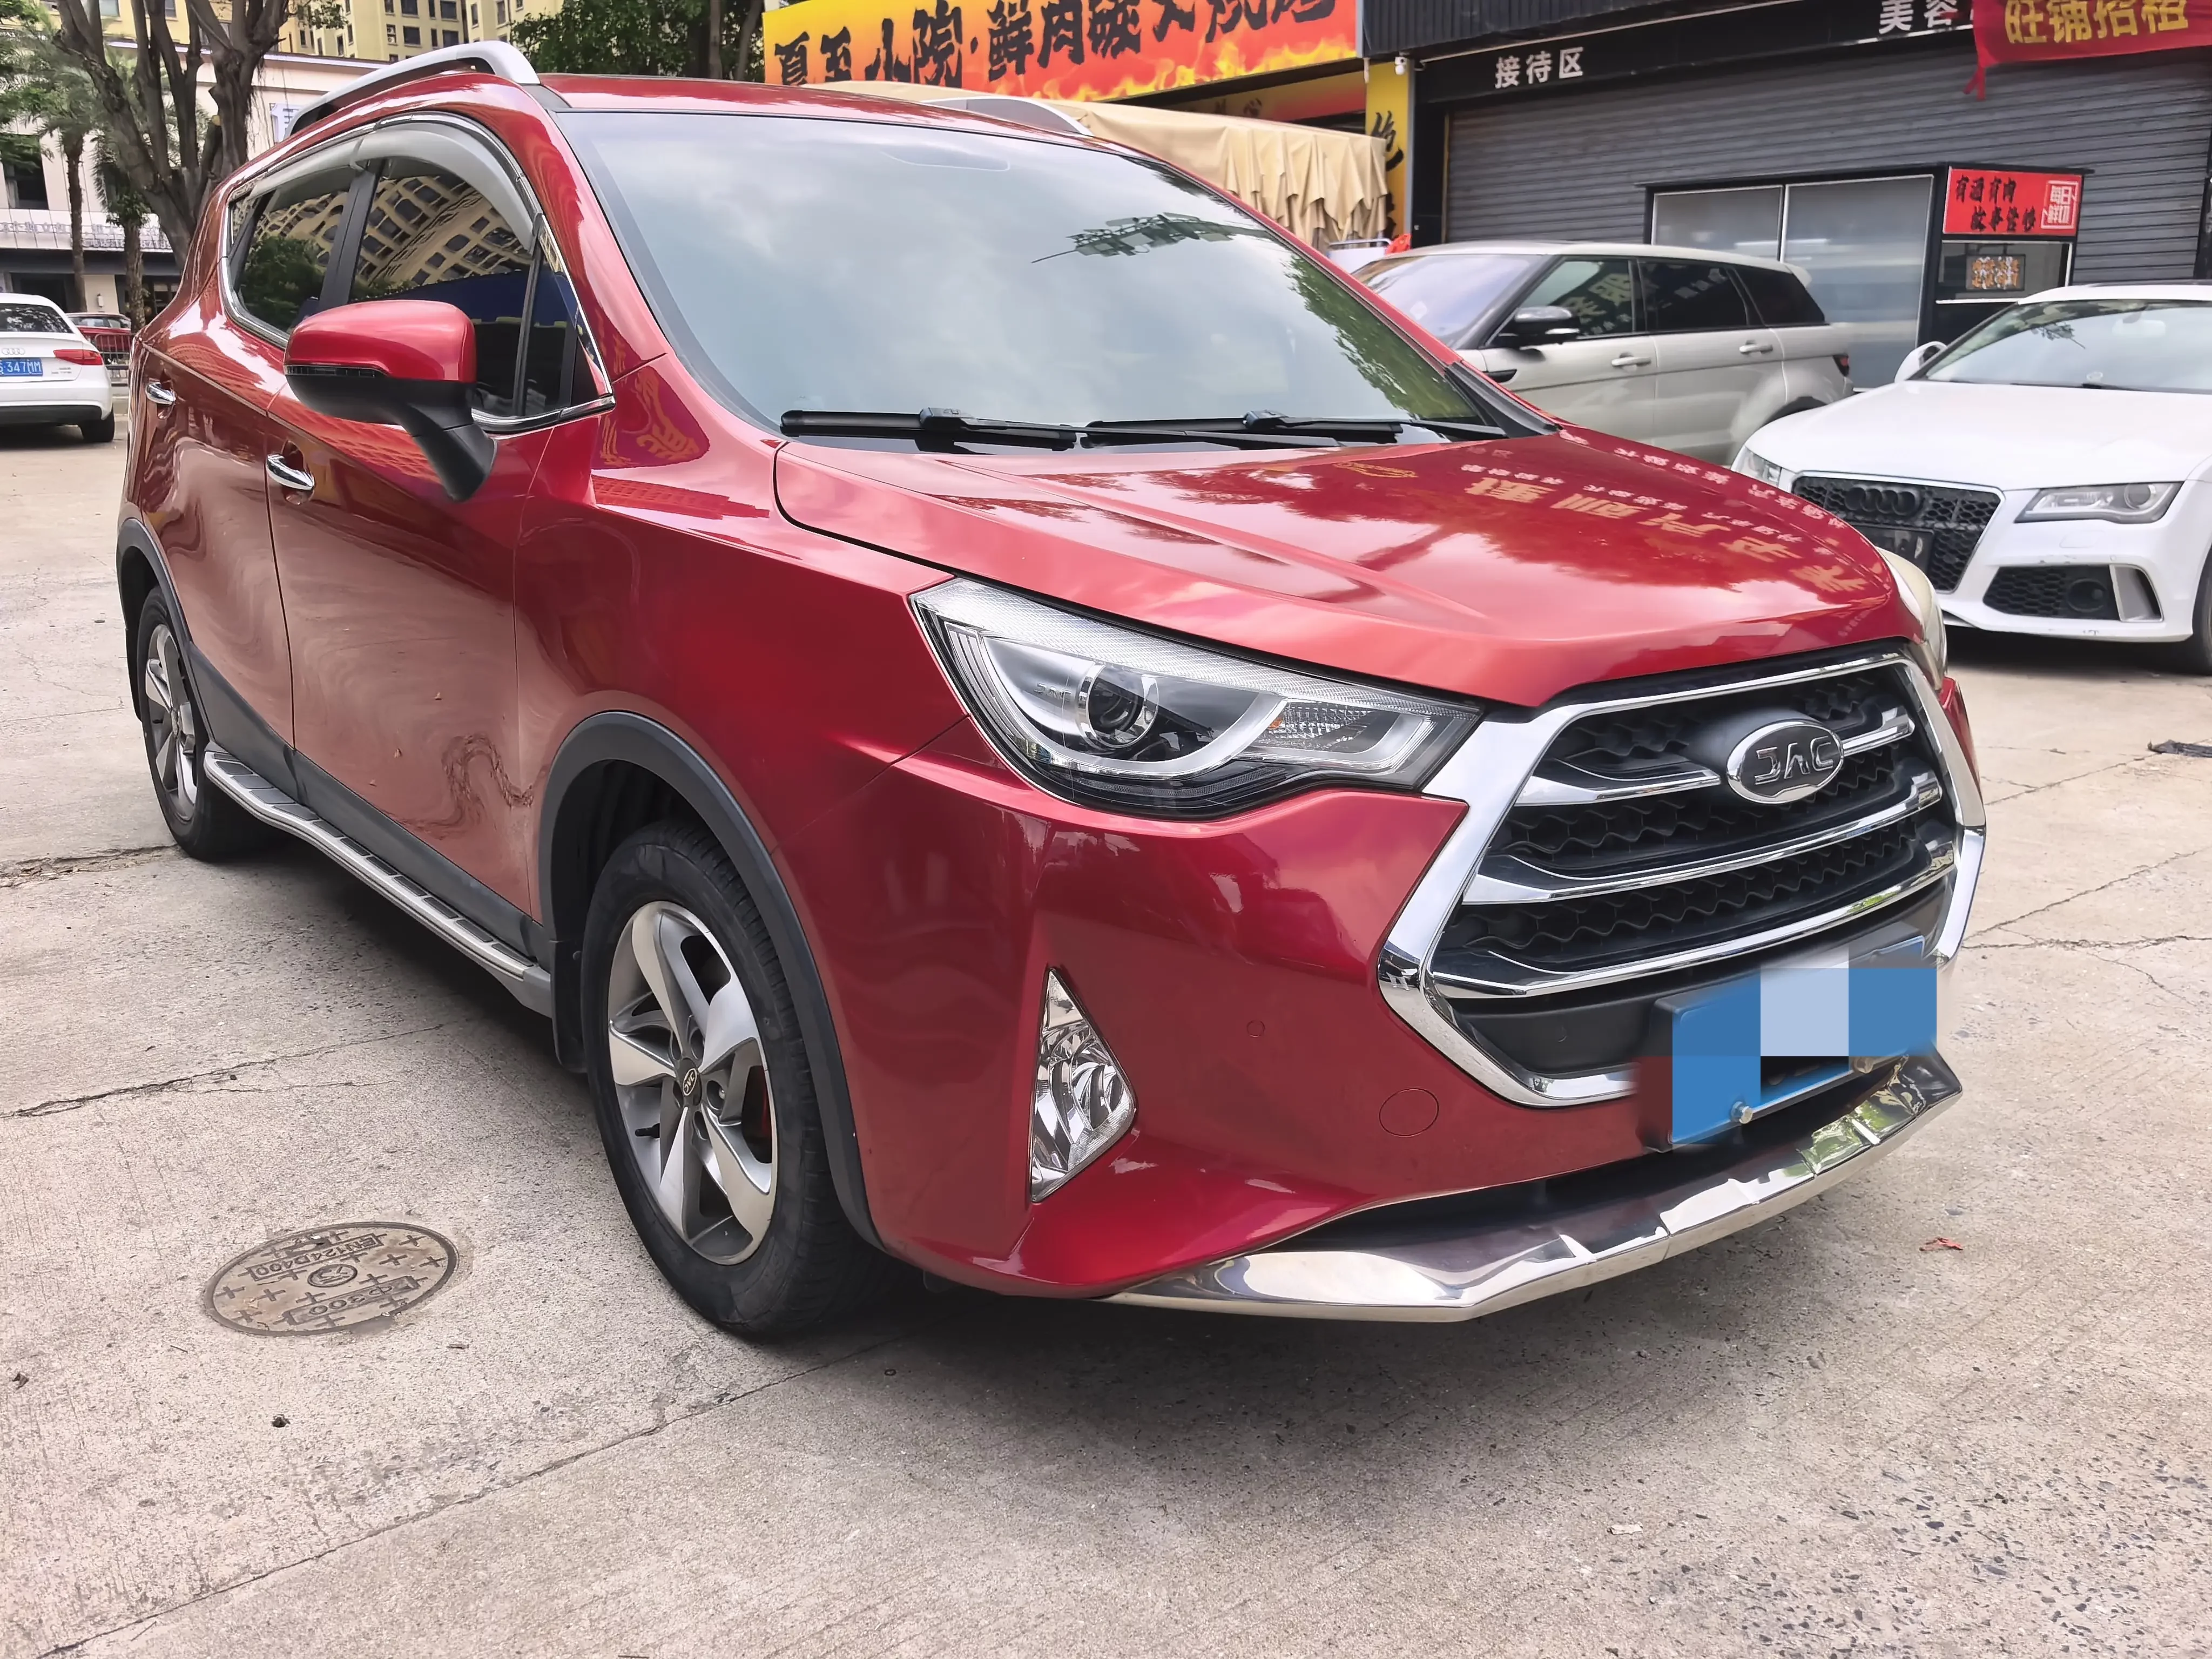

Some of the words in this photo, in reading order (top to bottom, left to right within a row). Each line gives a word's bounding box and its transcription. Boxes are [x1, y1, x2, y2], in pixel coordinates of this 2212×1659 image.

[1879, 0, 1974, 34] 美容
[1494, 46, 1583, 89] 接待区
[1754, 735, 1834, 785] JAC
